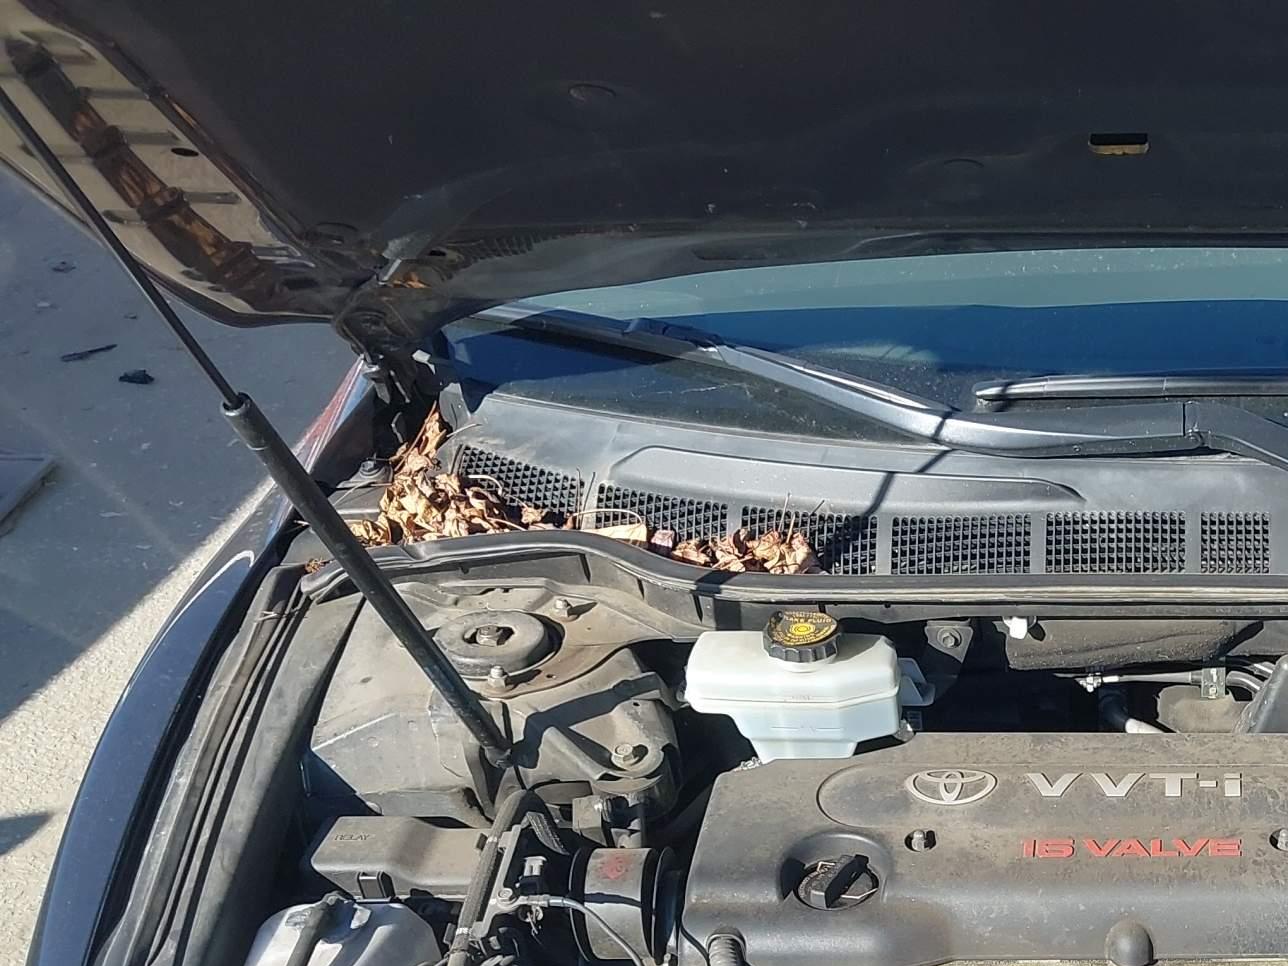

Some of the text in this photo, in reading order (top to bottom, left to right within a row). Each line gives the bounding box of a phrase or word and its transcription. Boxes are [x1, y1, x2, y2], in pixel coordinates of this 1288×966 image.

[1027, 772, 1243, 798] VVT-i
[1023, 838, 1243, 858] 16 VALVE
